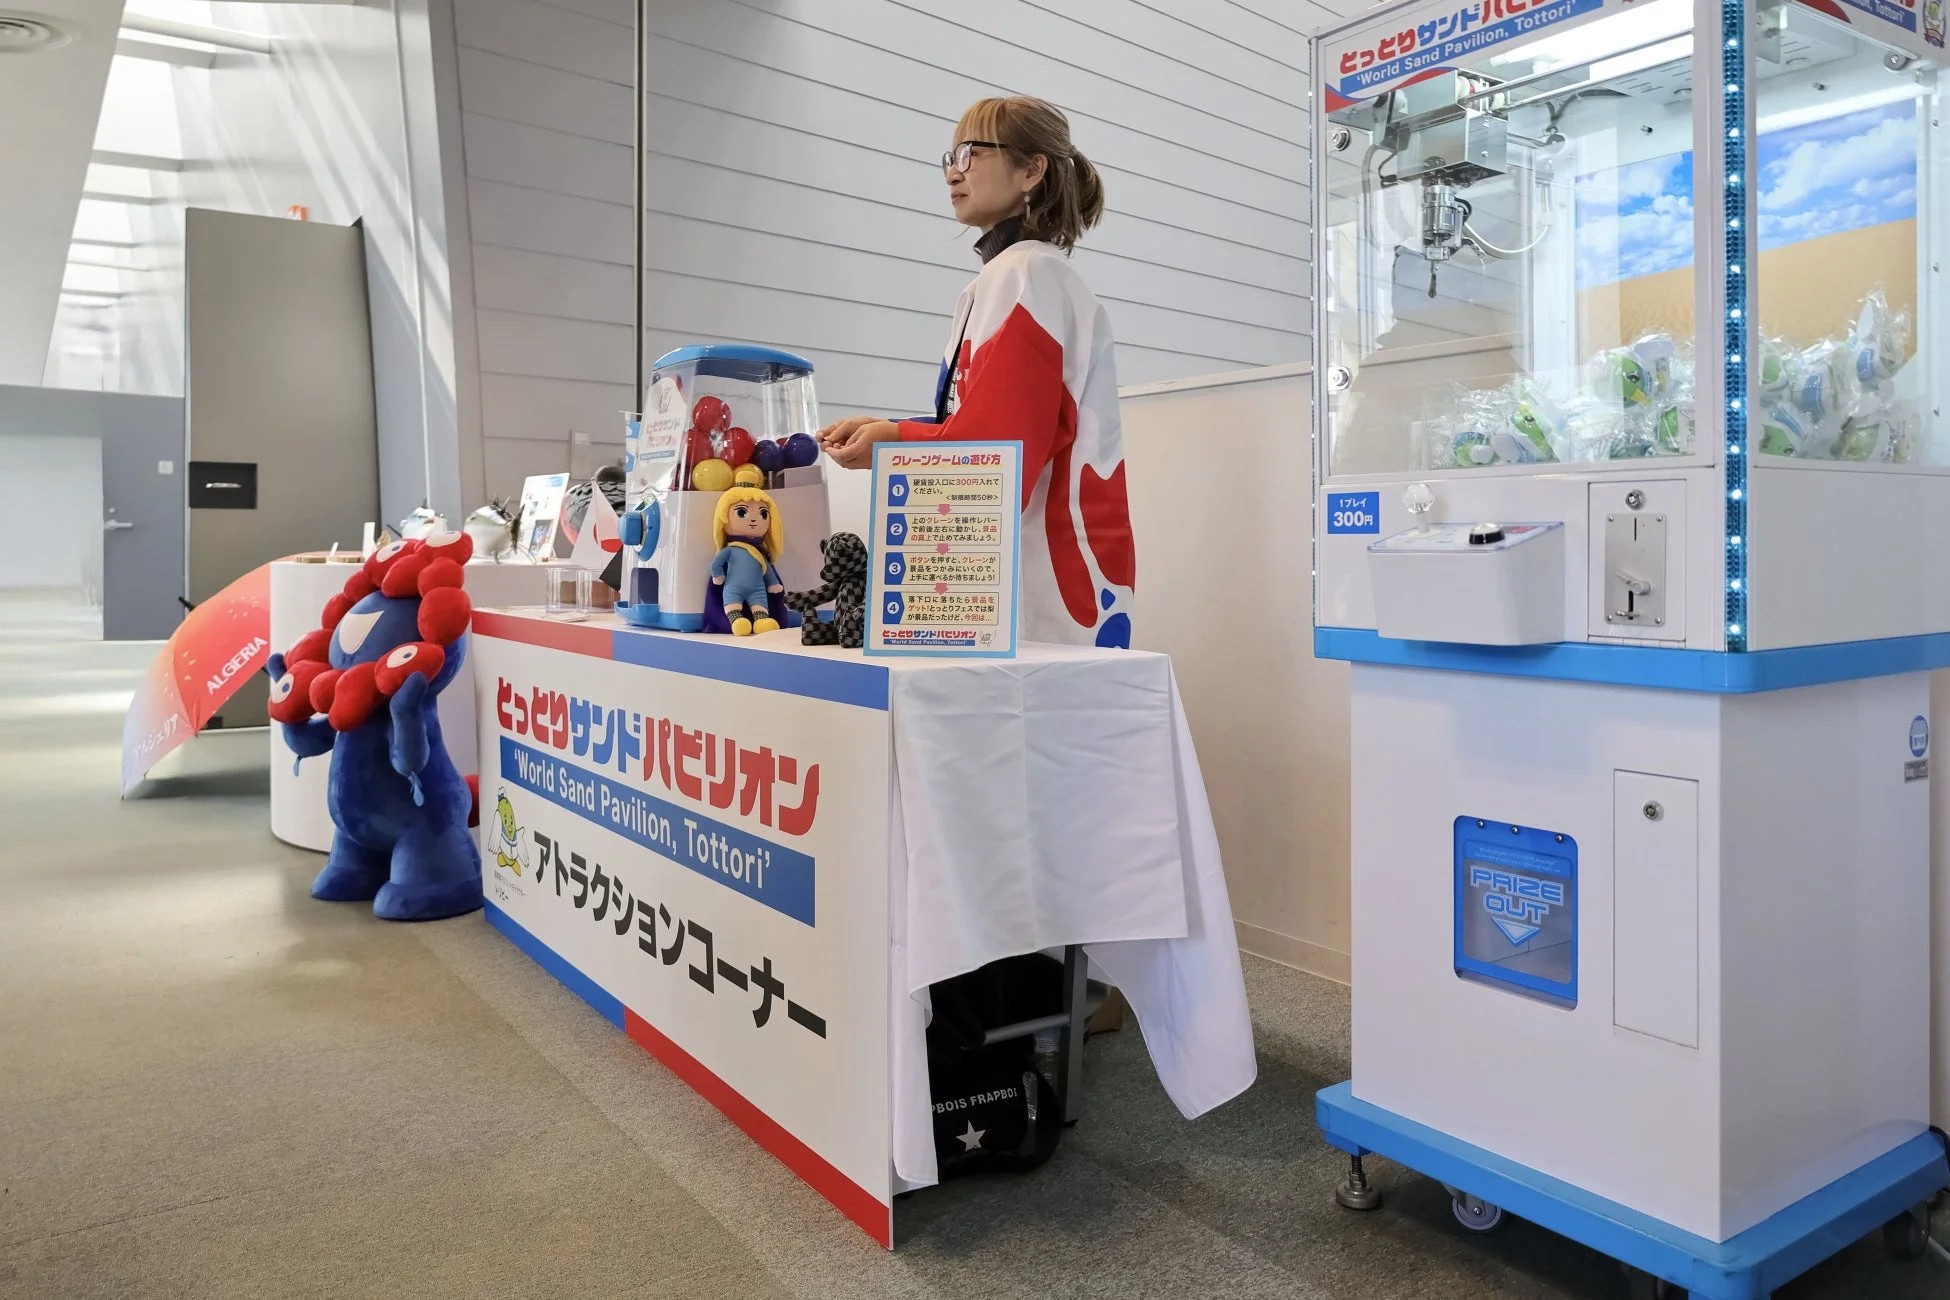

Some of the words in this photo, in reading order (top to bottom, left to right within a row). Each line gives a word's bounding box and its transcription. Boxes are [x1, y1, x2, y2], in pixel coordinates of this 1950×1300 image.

[1404, 51, 1439, 71] Sand
[1445, 27, 1508, 57] Pavilion,
[892, 454, 1001, 466] クレーンゲームの遊び方
[913, 478, 1000, 487] 硬貨投入口に300円入れて
[913, 487, 943, 495] ください。
[1339, 497, 1367, 508] 1プレイ
[911, 517, 998, 525] 上のクレーンを操作レバー
[1333, 510, 1374, 527] 300円
[911, 525, 998, 533] で前後左右に動かし、景品
[910, 534, 996, 542] の真上で止めてみましょう。
[910, 556, 996, 564] ボタンを押すと、クレーンが
[909, 565, 996, 573] 景品をつかみにいくので、
[908, 595, 995, 603] 落下口に落ちたら景品を
[882, 629, 977, 639] とっとりサンドパビリオン
[206, 636, 267, 695] ALGERIA
[497, 676, 820, 836] とっとりサンドパビリオン
[514, 748, 555, 793] ‘World
[559, 767, 595, 812] Sand
[600, 783, 677, 856] Pavilion,
[683, 817, 771, 889] Tottori’
[1470, 865, 1564, 906] PRIZE
[1483, 891, 1549, 924] OUT
[533, 830, 827, 1040] アトラクションコーナー
